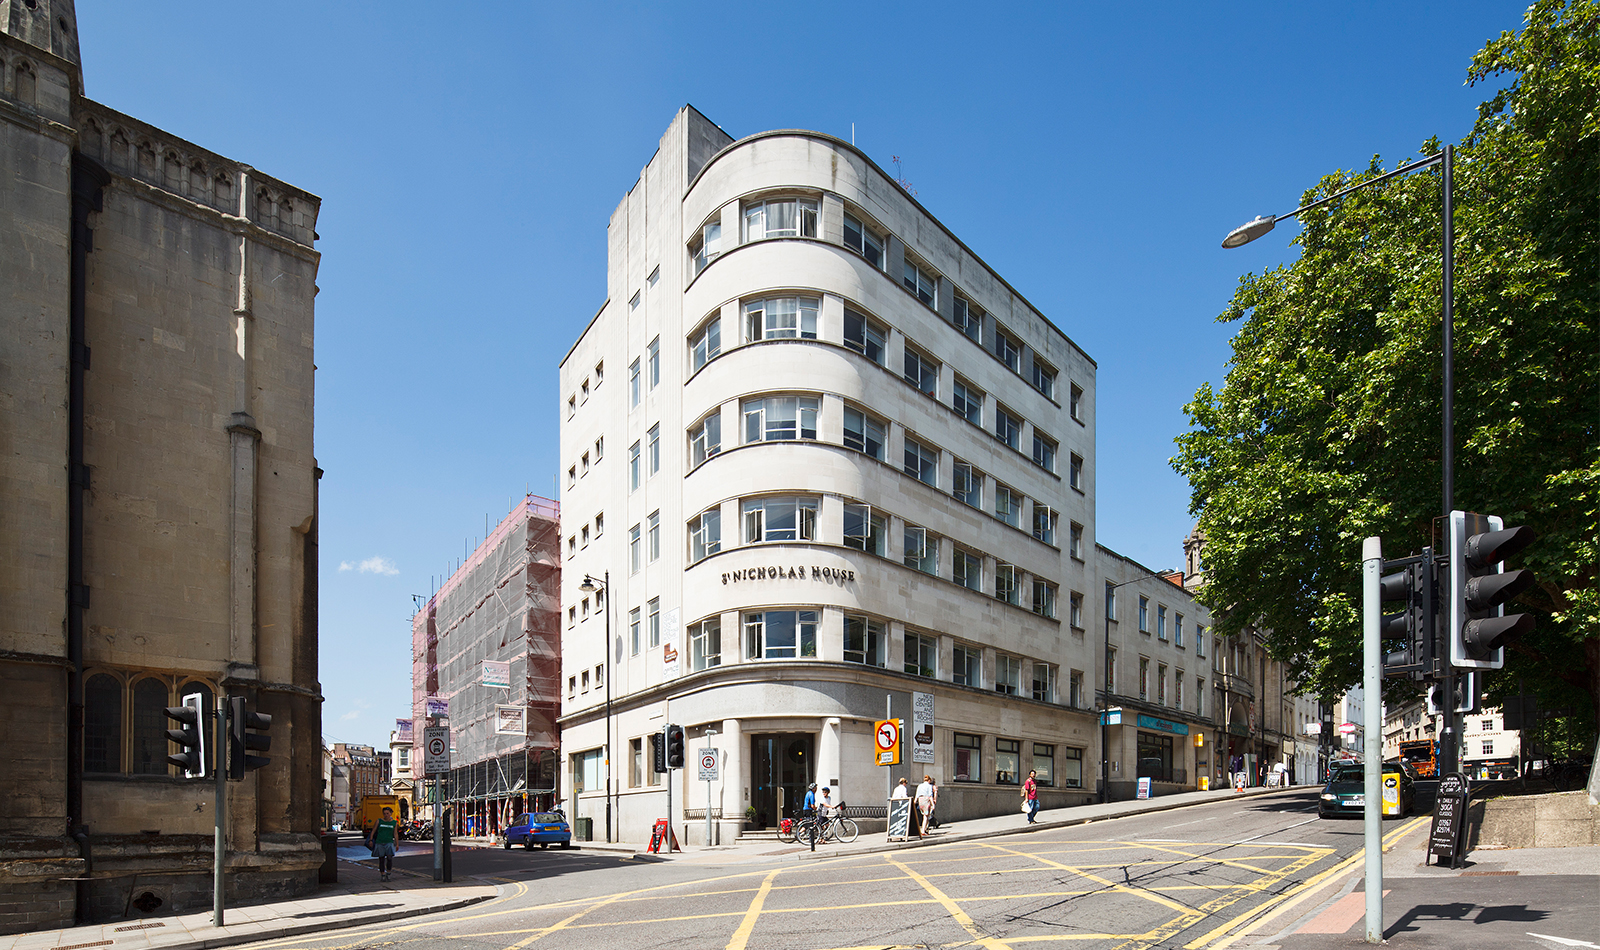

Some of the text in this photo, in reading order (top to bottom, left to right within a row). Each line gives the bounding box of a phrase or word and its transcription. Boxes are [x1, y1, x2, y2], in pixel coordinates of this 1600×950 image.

[733, 565, 806, 583] NICHOLAS
[810, 565, 856, 582] HOUSE
[1440, 803, 1453, 811] YOGA
